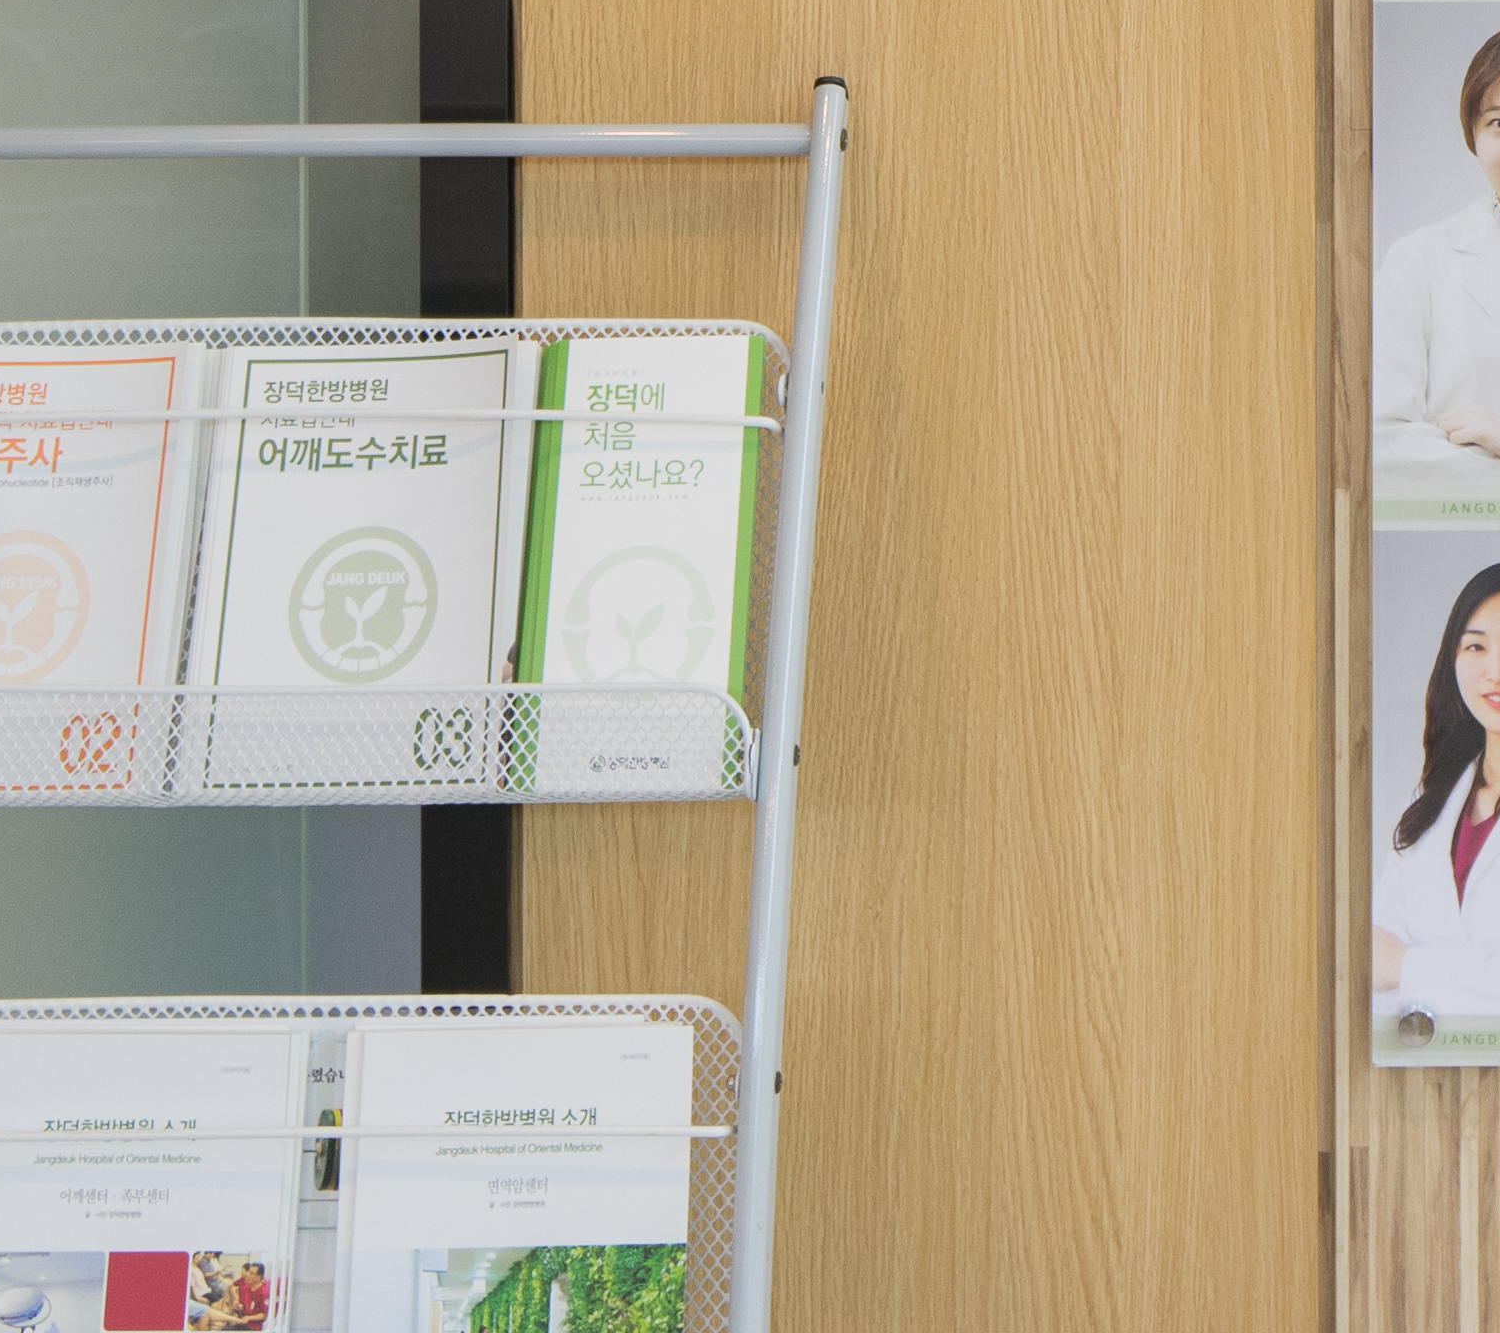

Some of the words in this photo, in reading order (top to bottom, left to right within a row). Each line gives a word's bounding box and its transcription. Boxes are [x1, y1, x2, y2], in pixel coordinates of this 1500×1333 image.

[263, 378, 390, 404] 장덕한방병원
[586, 383, 665, 413] 장덕에
[583, 420, 635, 452] 처음
[258, 434, 449, 473] 어깨도수치료
[579, 459, 705, 490] 오셨나요?
[326, 571, 365, 586] JANG
[366, 569, 406, 585] DEUK
[58, 711, 122, 777] 02
[34, 1154, 76, 1166] Jangdeuk
[78, 1155, 114, 1165] Hospital
[115, 1154, 125, 1163] of
[125, 1153, 160, 1164] Oriental
[162, 1153, 202, 1164] Medicine
[435, 1146, 479, 1157] Jangdeuk
[480, 1145, 516, 1155] Hospital
[517, 1144, 527, 1154] of
[527, 1143, 562, 1154] Oriental
[563, 1142, 604, 1153] Medicine
[487, 1176, 549, 1195] 면역암센터
